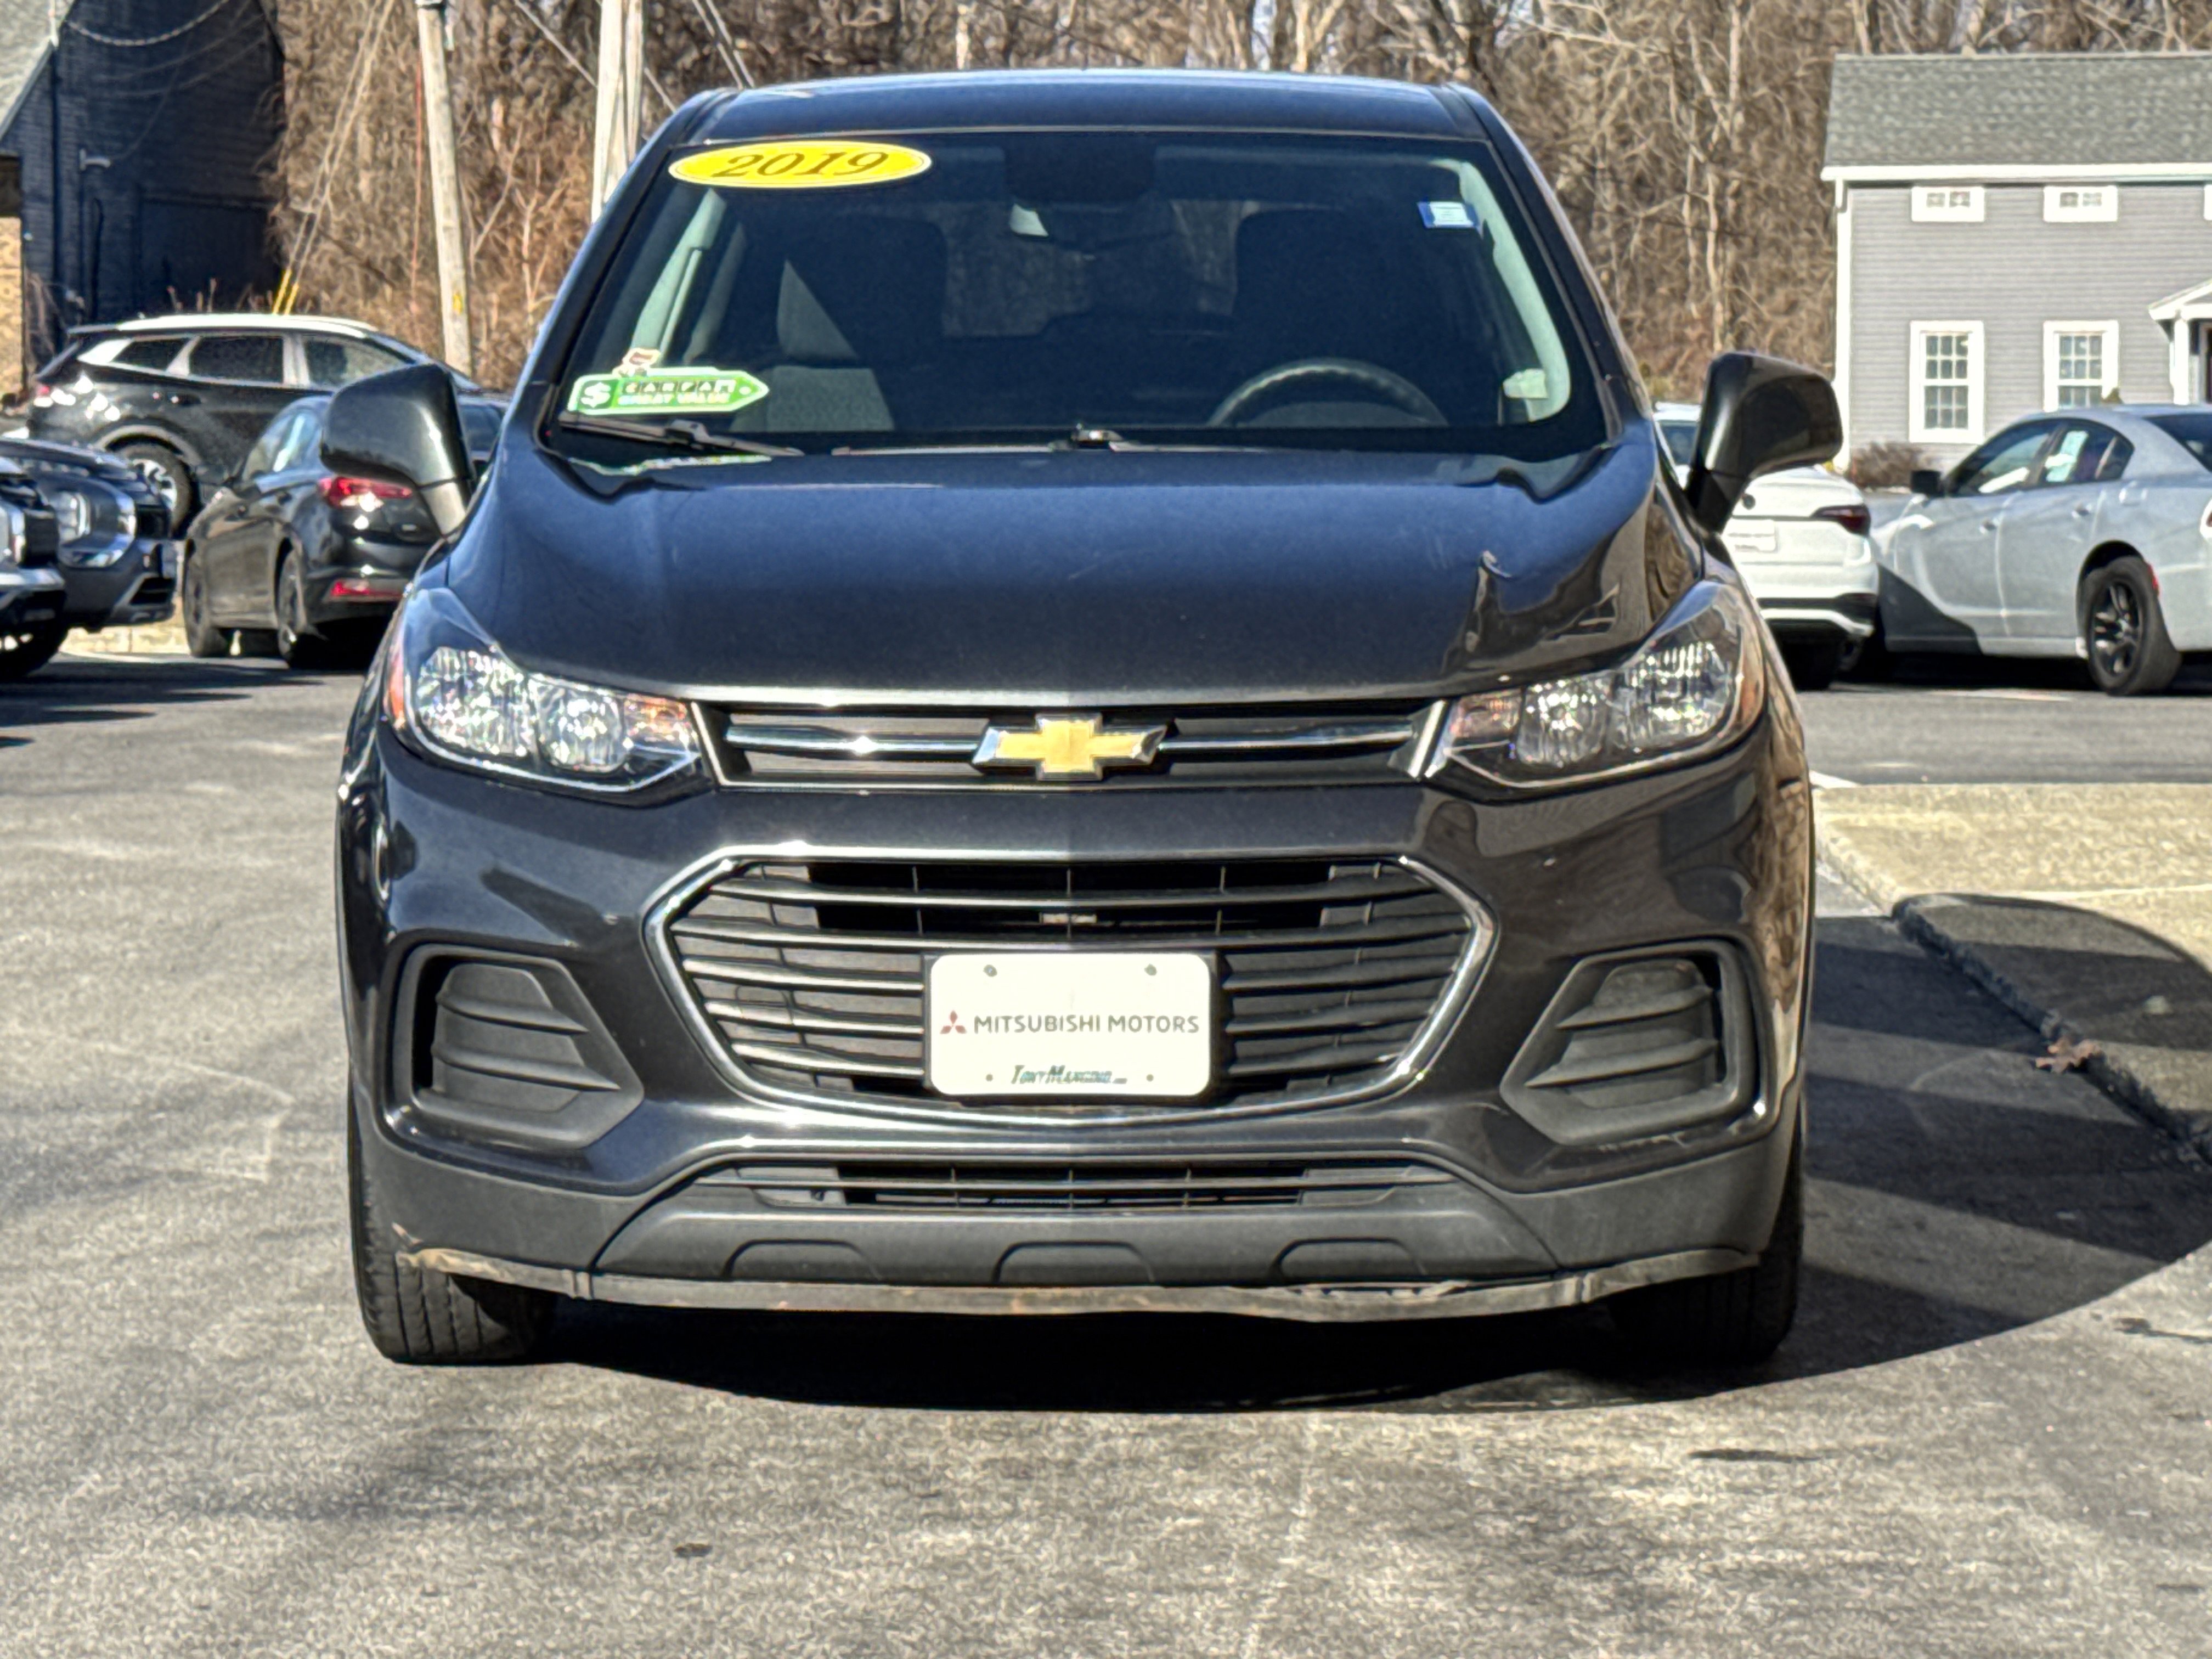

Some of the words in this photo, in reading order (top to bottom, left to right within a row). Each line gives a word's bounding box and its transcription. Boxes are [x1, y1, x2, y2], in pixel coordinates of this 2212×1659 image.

[710, 151, 889, 177] 2019
[974, 1014, 1101, 1034] MITSUBISHI
[1108, 1014, 1200, 1034] MOTORS
